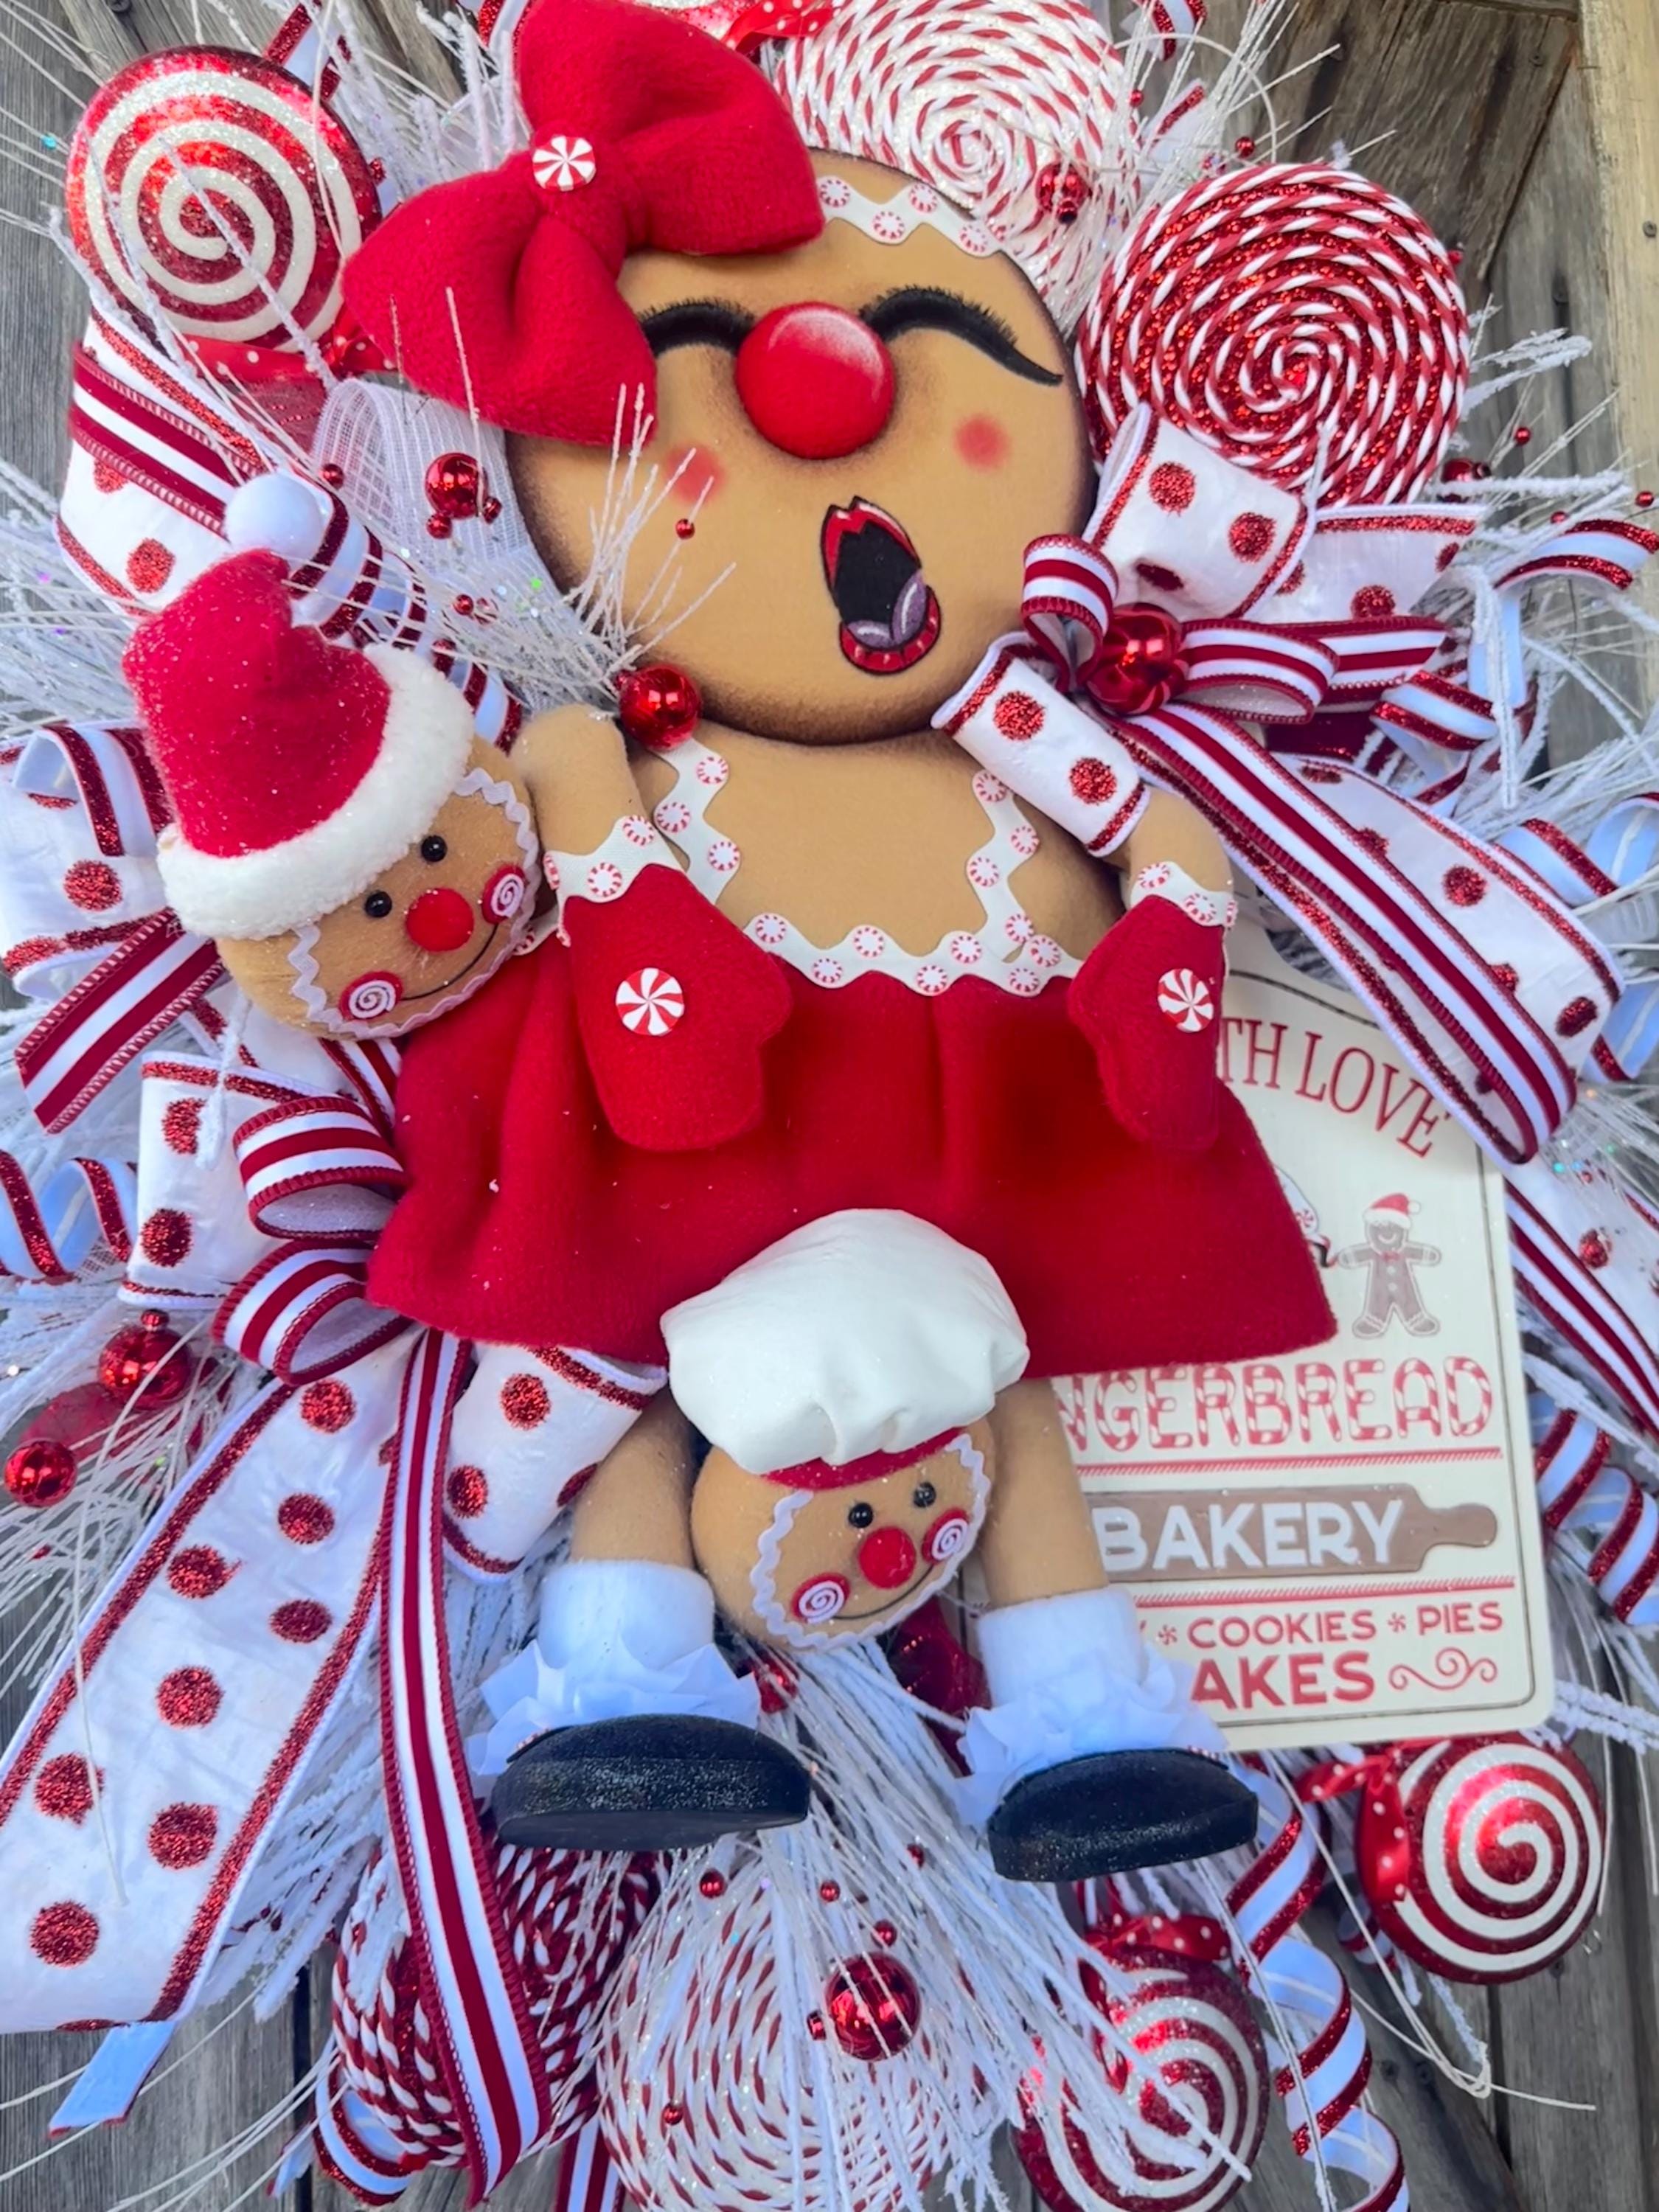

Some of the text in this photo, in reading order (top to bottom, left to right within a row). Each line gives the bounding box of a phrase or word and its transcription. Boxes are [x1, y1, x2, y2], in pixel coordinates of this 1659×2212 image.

[1294, 1031, 1451, 1158] LOVE
[1091, 1499, 1403, 1571] BAKERY
[1187, 1609, 1377, 1649] COOKIES
[1416, 1601, 1503, 1636] PIES
